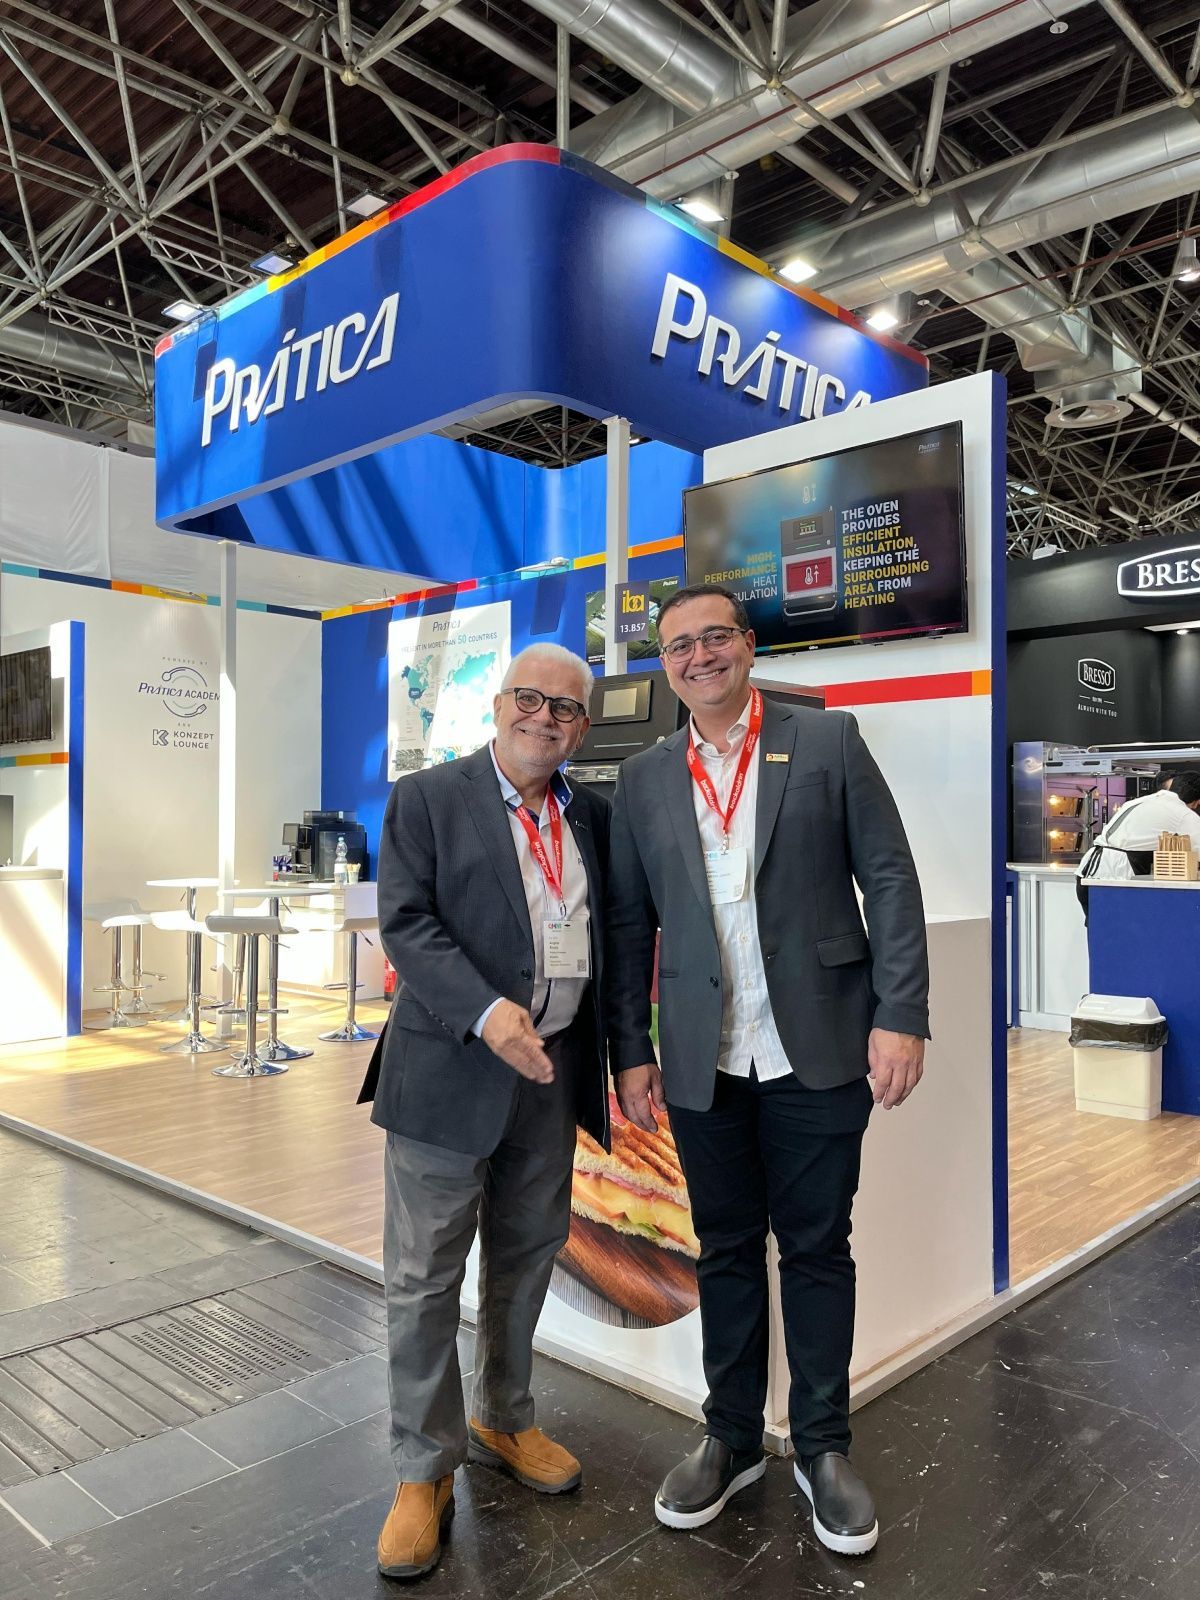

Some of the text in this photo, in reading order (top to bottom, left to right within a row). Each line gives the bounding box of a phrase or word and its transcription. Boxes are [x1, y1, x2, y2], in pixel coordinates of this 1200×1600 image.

[201, 292, 400, 447] PRÁTICA
[841, 500, 899, 521] THE OVEN
[842, 513, 900, 533] PROVIDES
[842, 526, 902, 547] EFFICIENT
[746, 551, 776, 565] HIGH-
[843, 536, 917, 559] INSULATION,
[843, 548, 920, 572] KEEPING THE
[704, 562, 777, 584] PERFORMANCE
[753, 574, 778, 588] HEAT
[843, 560, 930, 584] SURROUNDING
[1137, 558, 1200, 588] BRES
[733, 586, 778, 602] ULATION
[844, 576, 912, 597] AREA FROM
[622, 589, 645, 613] iba
[844, 592, 895, 609] HEATING
[428, 641, 441, 649] MORE
[442, 639, 456, 647] THAN
[457, 634, 467, 644] 50
[468, 632, 498, 643] COUNTRIES
[184, 689, 220, 701] ACADEM
[173, 730, 215, 740] KONZEPT
[173, 740, 209, 749] LOUNGE
[729, 772, 744, 810] backaldrin
